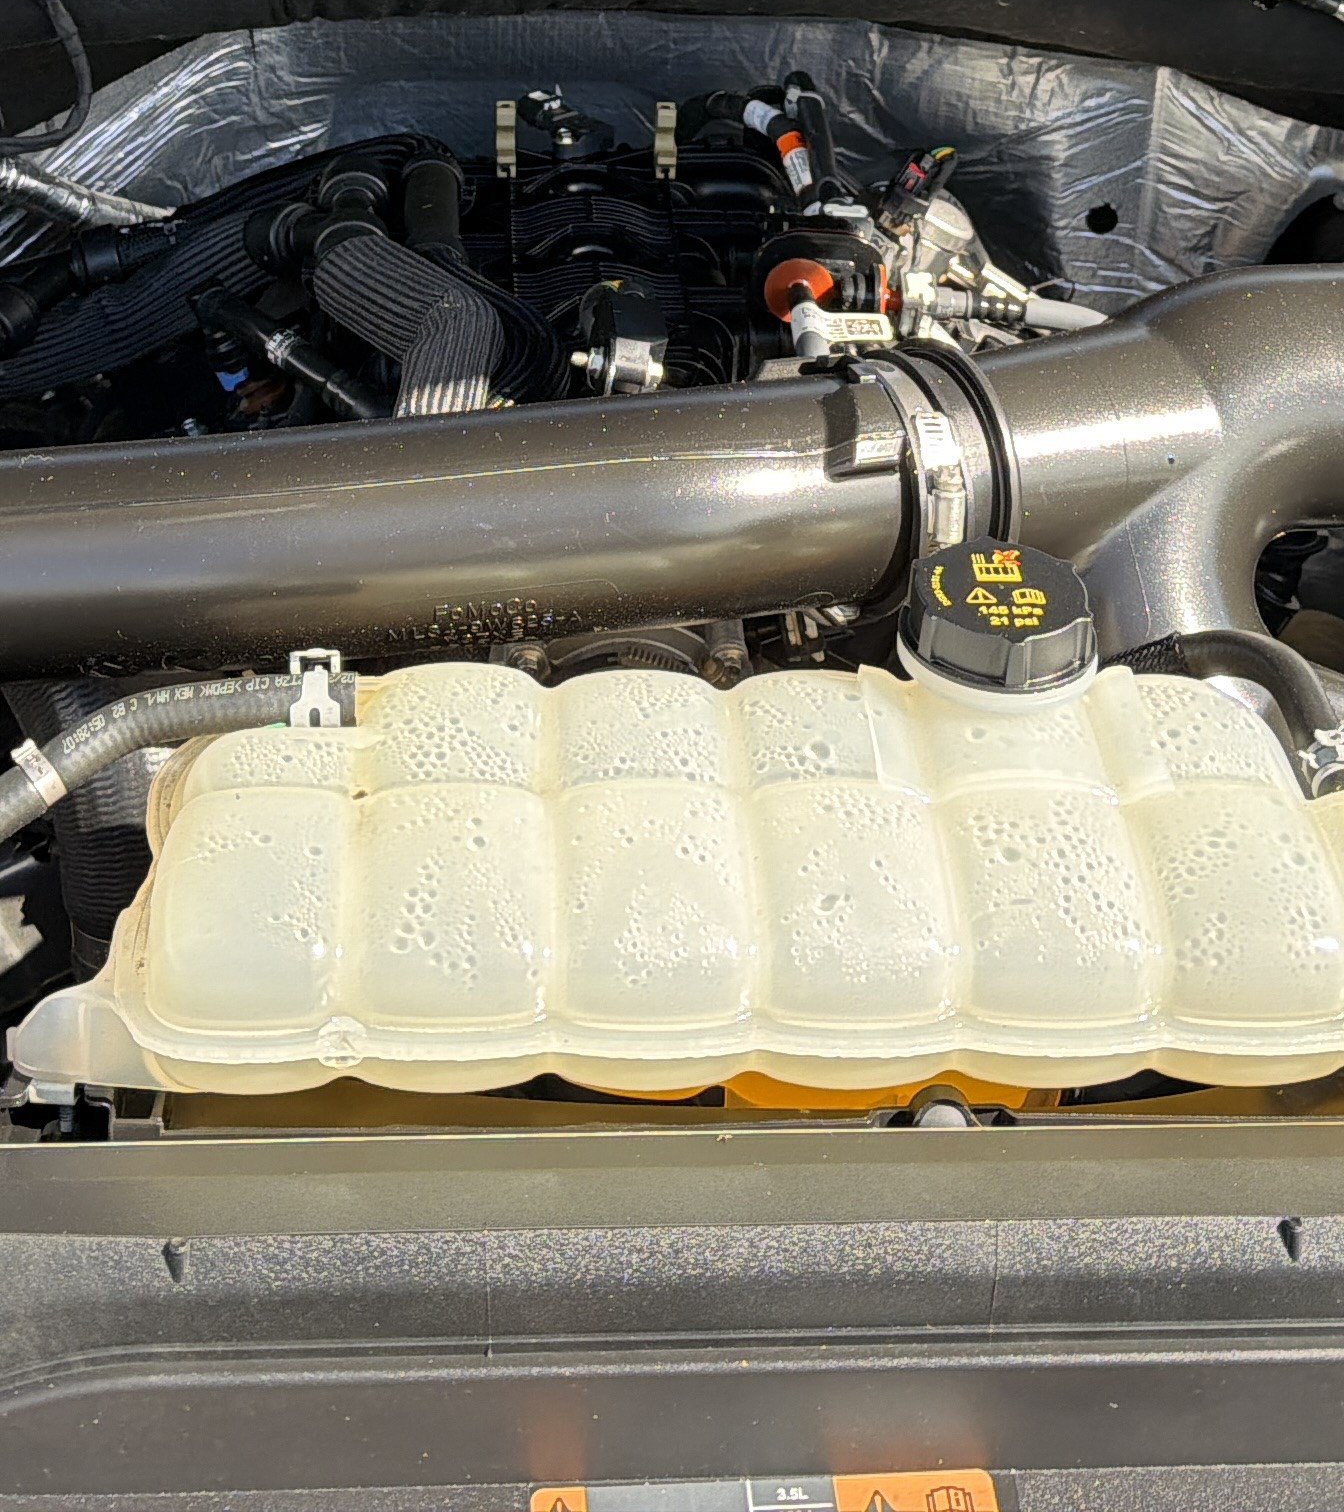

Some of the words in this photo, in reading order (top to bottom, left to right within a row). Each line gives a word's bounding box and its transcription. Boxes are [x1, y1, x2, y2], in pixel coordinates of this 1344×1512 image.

[1012, 605, 1045, 616] kPa
[989, 616, 1010, 626] 21
[1014, 616, 1040, 628] psi
[174, 686, 195, 701] MEX
[129, 698, 138, 711] C
[61, 713, 106, 755] 05:28:07
[777, 1487, 809, 1501] 3.5L
